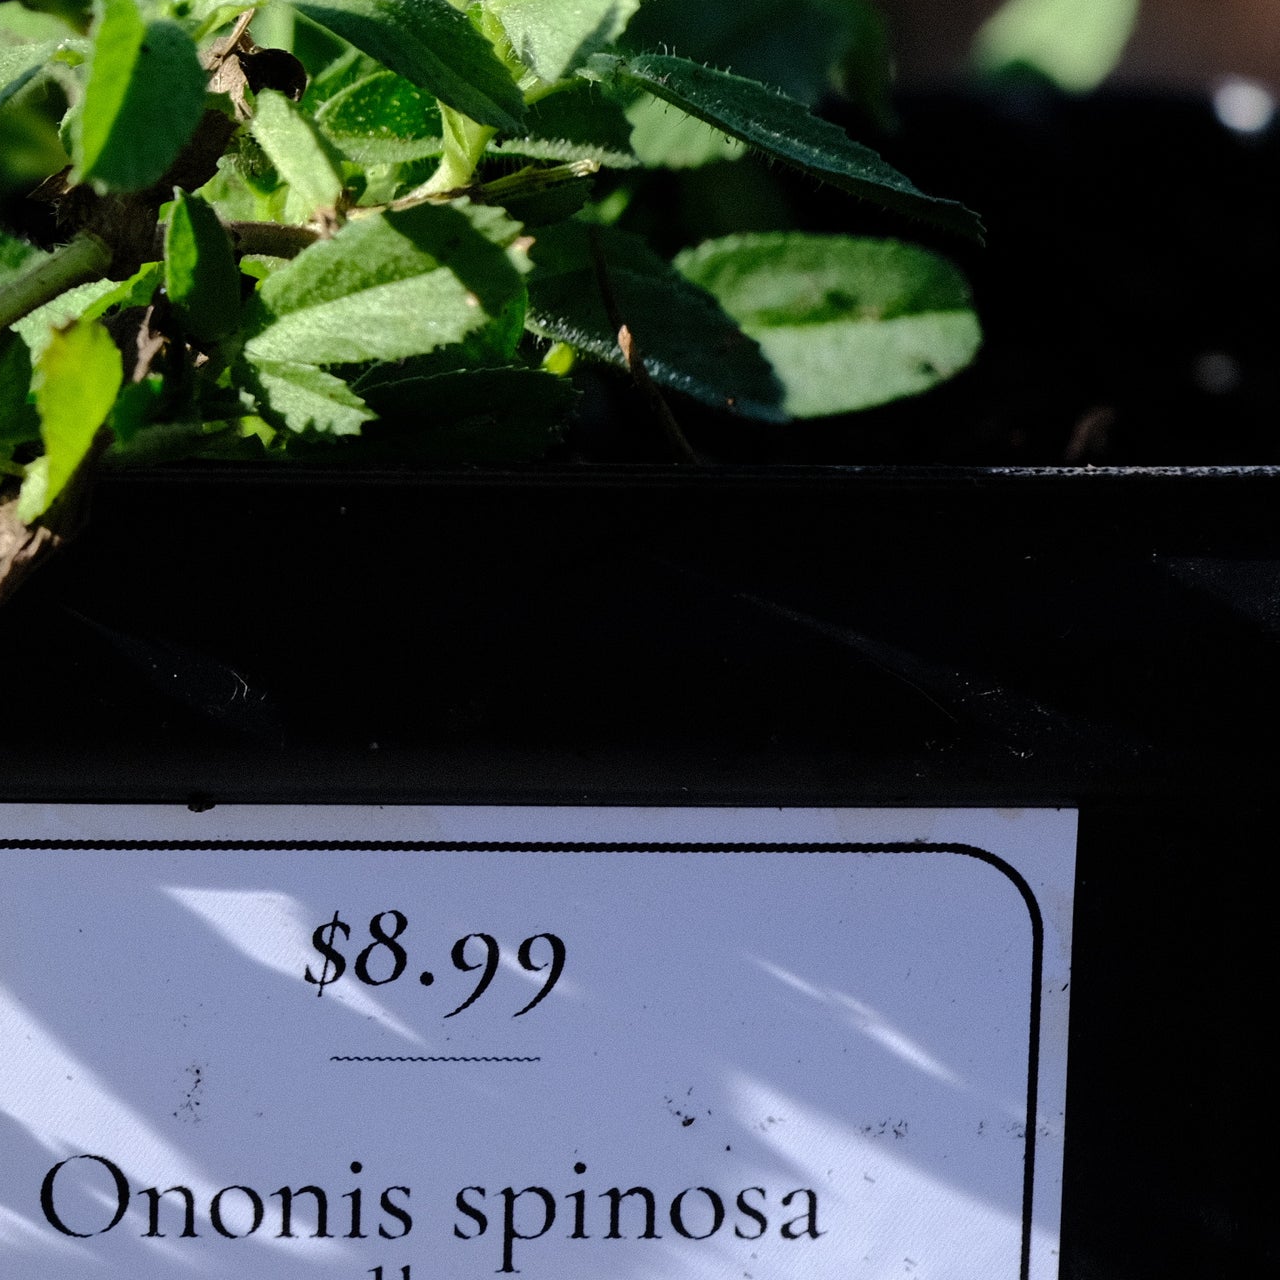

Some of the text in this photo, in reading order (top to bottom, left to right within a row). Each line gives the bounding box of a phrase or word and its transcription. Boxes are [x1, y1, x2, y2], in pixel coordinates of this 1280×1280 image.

[303, 908, 568, 1019] $8.99
[39, 1154, 828, 1274] Ononis spinosa
